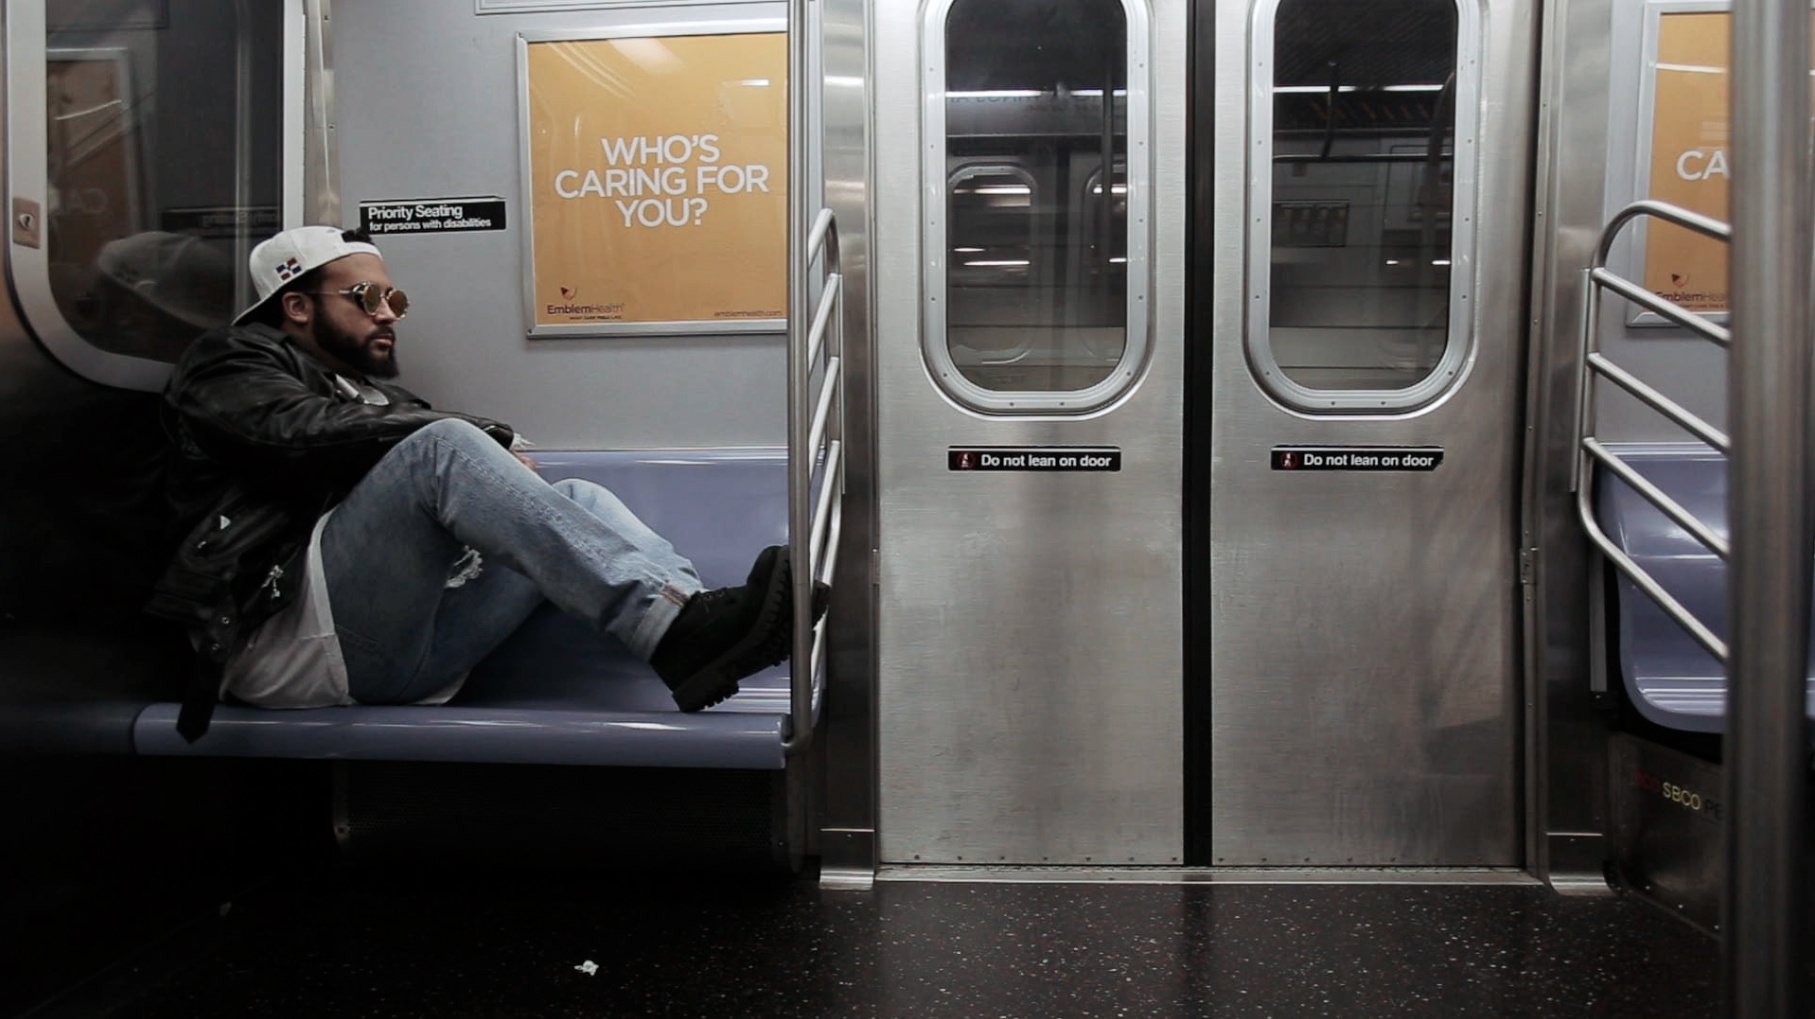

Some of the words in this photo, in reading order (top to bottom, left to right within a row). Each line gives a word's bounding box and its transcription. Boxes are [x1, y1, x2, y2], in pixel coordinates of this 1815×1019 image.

[600, 134, 720, 166] WHO'S
[554, 166, 687, 199] CARING
[696, 165, 770, 194] FOR
[368, 205, 414, 221] Priority
[415, 203, 463, 219] Seating
[615, 197, 708, 228] YOU?
[369, 221, 383, 231] for
[384, 221, 421, 232] persons
[422, 219, 442, 230] with
[443, 217, 491, 228] disabilities
[980, 454, 1000, 466] Do
[1003, 454, 1025, 467] not
[1028, 454, 1056, 467] lean
[1059, 456, 1076, 467] on
[1079, 454, 1112, 467] door
[1303, 453, 1323, 466] Do
[1326, 454, 1348, 466] not
[1350, 454, 1378, 466] lean
[1381, 456, 1399, 466] on
[1402, 454, 1434, 466] door
[1662, 781, 1701, 810] SBCO
